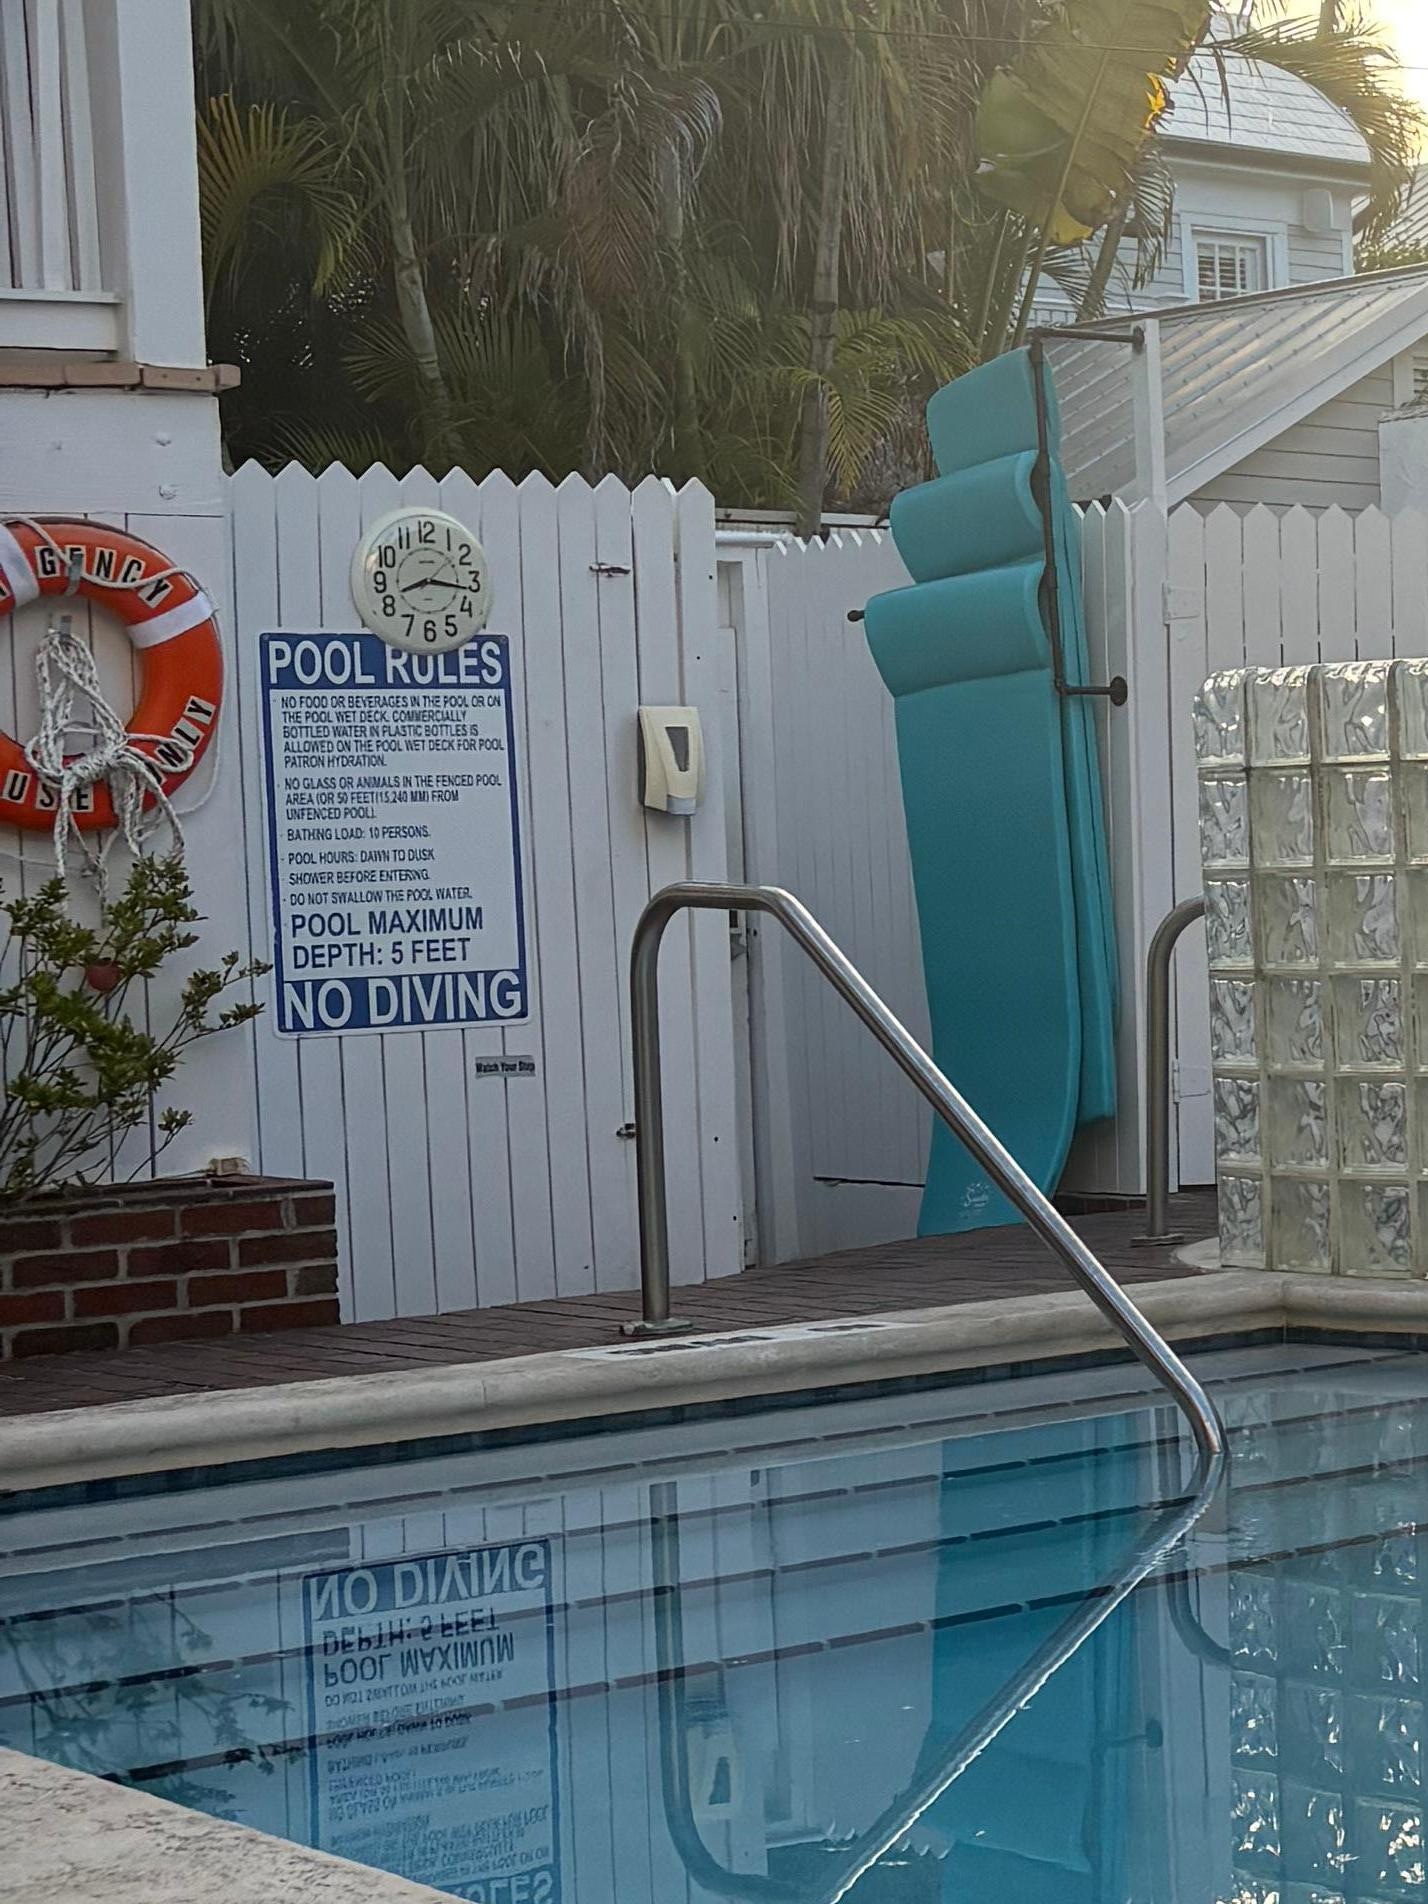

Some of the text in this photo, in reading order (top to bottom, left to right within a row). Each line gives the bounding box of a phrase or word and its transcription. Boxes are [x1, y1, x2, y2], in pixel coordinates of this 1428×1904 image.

[398, 526, 410, 549] 11
[418, 520, 436, 544] 12
[378, 544, 396, 568] 10
[458, 543, 472, 566] 2
[373, 570, 387, 594] 9
[468, 570, 481, 593] 3
[382, 594, 396, 617] 8
[459, 595, 473, 618] 4
[401, 614, 415, 637] 7
[423, 619, 437, 642] 6
[444, 614, 458, 637] 5
[268, 640, 502, 685] POOL RULES
[281, 695, 501, 708] NO FOOD OR BEVERAGES IN THE POOL OR ON
[283, 711, 302, 723] THE
[305, 711, 333, 723] POOL
[334, 711, 357, 723] WET
[392, 710, 467, 722] COMMERCIALLY
[283, 724, 479, 738] BOTTLED WATER IN PLASTIC BOTTLES IS
[284, 738, 505, 753] ALLOWED ON THE POOL WET DECK FOR POOL
[285, 755, 325, 768] PATRON
[285, 774, 502, 790] NO GLASS OR ANIMALS IN THE FENCED POOL
[286, 792, 315, 805] AREA
[316, 792, 335, 805] (OR
[432, 790, 459, 802] FROM
[286, 807, 341, 820] UNFENCED
[287, 828, 333, 841] BATHING
[369, 827, 380, 839] 10
[288, 852, 317, 865] POOL
[360, 850, 390, 863] DAWN
[392, 849, 406, 862] TO
[408, 848, 435, 861] DUSK
[289, 872, 335, 885] SHOWER
[337, 870, 377, 883] BEFORE
[290, 893, 305, 906] DO
[307, 892, 328, 905] NOT
[331, 890, 383, 904] SWALLOW
[384, 889, 404, 902] THE
[406, 888, 433, 901] POOL
[291, 906, 483, 938] POOL MAXIMUM
[293, 937, 471, 969] DEPTH: 5 FEET
[284, 970, 522, 1030] NO DIVING
